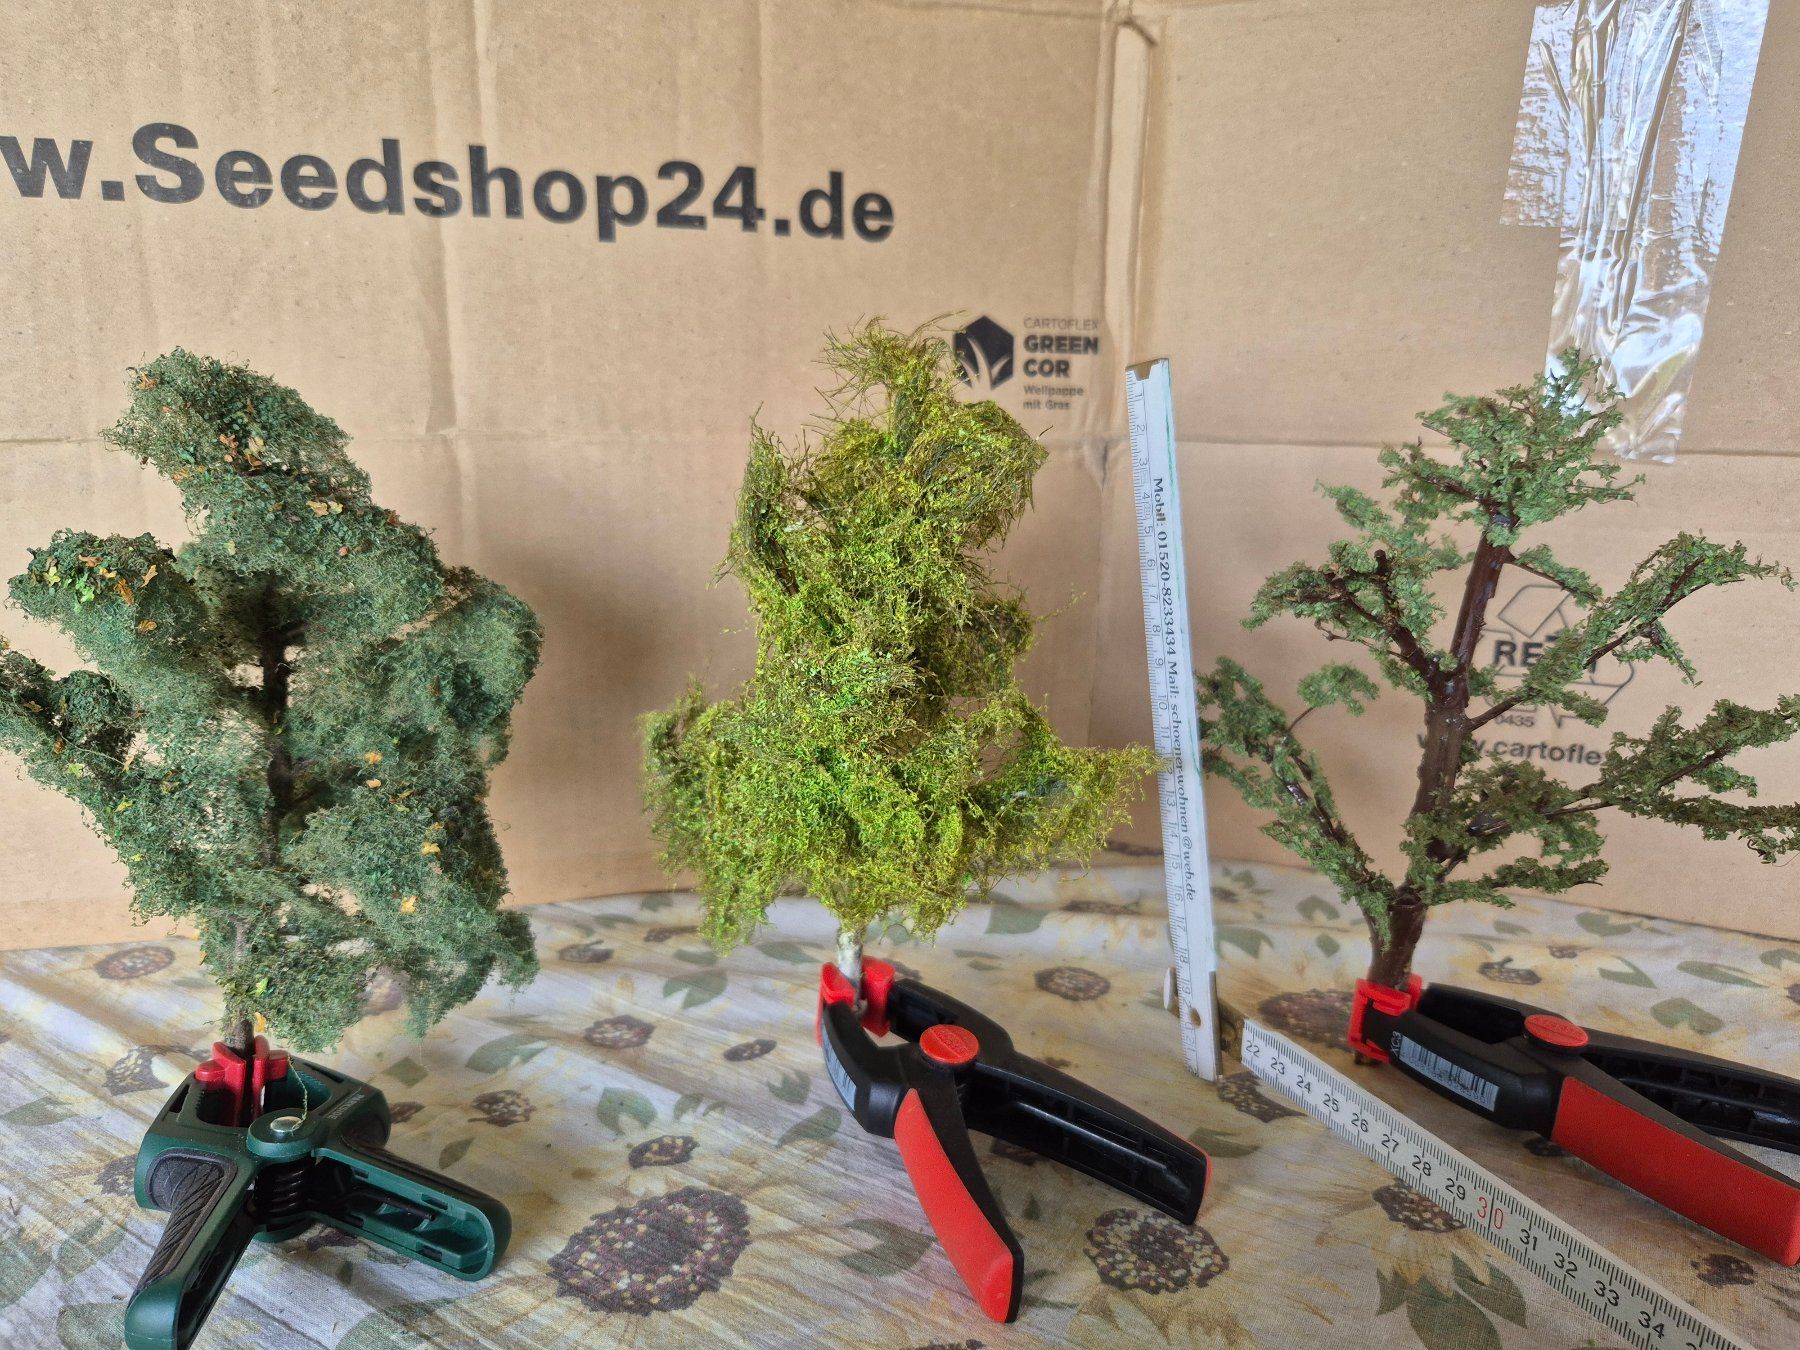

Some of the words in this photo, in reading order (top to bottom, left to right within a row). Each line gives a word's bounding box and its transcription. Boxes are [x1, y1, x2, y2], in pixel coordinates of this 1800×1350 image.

[0, 122, 895, 243] w.Seedshop24.de
[1023, 317, 1099, 331] CARTOFLEX
[1023, 334, 1099, 355] GREEN
[1023, 358, 1071, 378] COR
[1023, 385, 1084, 398] Wellpappe
[1023, 399, 1042, 410] mit
[1045, 400, 1071, 410] Gras
[1136, 424, 1146, 432] 2
[1138, 457, 1148, 467] 3
[1142, 491, 1151, 500] 4
[1153, 477, 1167, 527] Mobil:
[1144, 525, 1153, 535] 5
[1146, 559, 1156, 568] 6
[1157, 531, 1177, 655] 01520-8233434
[1152, 624, 1161, 633] 8
[1154, 658, 1164, 666] 9
[1168, 661, 1180, 698] Mail:
[1157, 695, 1168, 711] 10
[1160, 726, 1170, 739] 11
[1165, 790, 1176, 807] 13
[1168, 822, 1179, 838] 14
[1171, 854, 1182, 870] 15
[1174, 885, 1184, 902] 16
[1176, 916, 1186, 933] 17
[1179, 948, 1190, 965] 18
[1181, 978, 1192, 995] 19
[1245, 1040, 1260, 1058] 22
[1270, 1057, 1286, 1075] 23
[1296, 1075, 1312, 1094] 24
[1323, 1093, 1340, 1113] 25
[1351, 1112, 1369, 1133] 26
[1381, 1133, 1400, 1153] 27
[1411, 1154, 1432, 1177] 28
[1445, 1177, 1467, 1200] 29
[1477, 1196, 1504, 1230] 30
[1519, 1228, 1538, 1252] 31
[1553, 1252, 1578, 1279] 32
[1593, 1279, 1620, 1307] 33
[1637, 1310, 1665, 1340] 34
